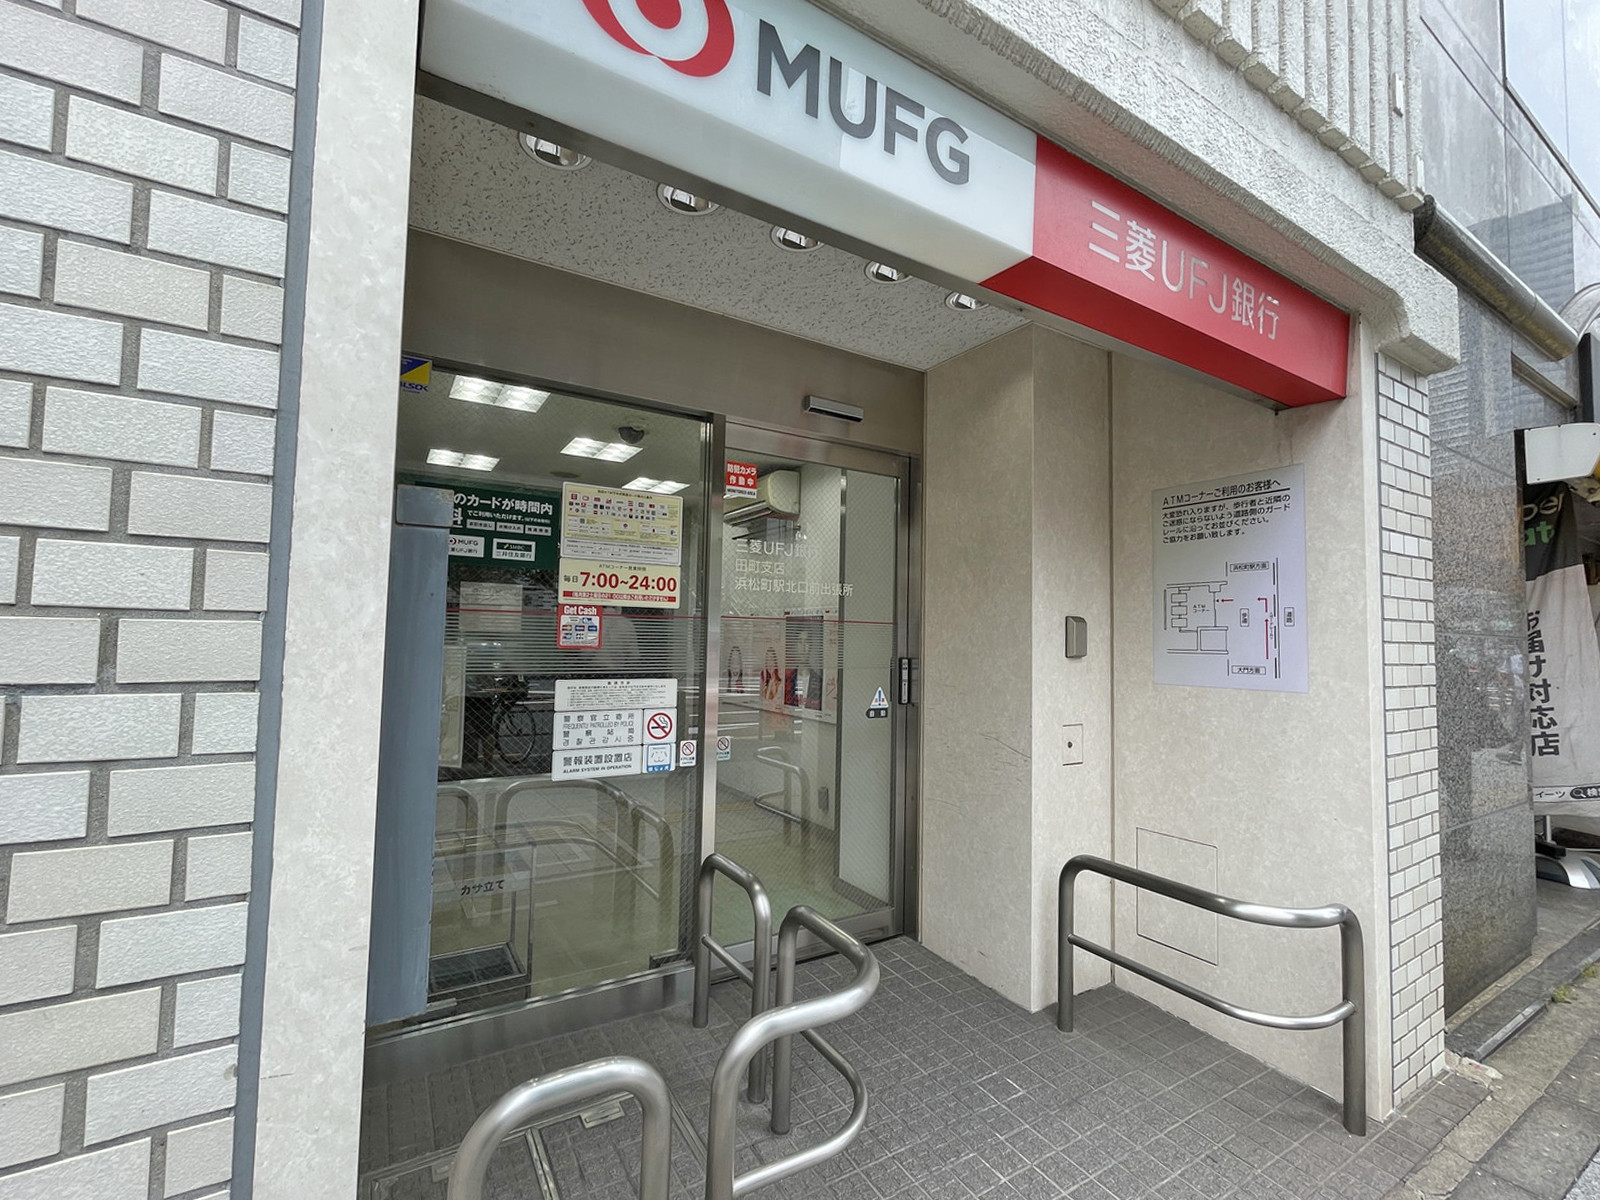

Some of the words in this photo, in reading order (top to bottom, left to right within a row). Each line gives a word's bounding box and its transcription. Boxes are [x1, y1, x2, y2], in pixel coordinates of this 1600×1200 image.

[757, 19, 969, 185] MUFG
[1089, 200, 1280, 340] 三菱UFJ銀行
[401, 381, 429, 392] LSOK
[727, 463, 757, 476] 防犯カメラ
[729, 474, 754, 487] 作動中
[1162, 479, 1281, 506] ATMコーナーご利用のお客様へ
[1162, 494, 1290, 520] 大変恐れ入りますが、歩行者と近隣の
[1162, 503, 1291, 528] ご迷惑にならないよう道路側のガード
[1162, 516, 1269, 536] レールに沿ってお並びください。
[735, 558, 785, 575] 田町支店
[563, 574, 579, 583] 毎日
[734, 576, 854, 597] 浜松町駅北口前出張所
[563, 605, 577, 615] Get
[578, 605, 597, 615] Cash
[563, 752, 633, 767] 警報装置設置店
[461, 879, 505, 897] カサ立て
